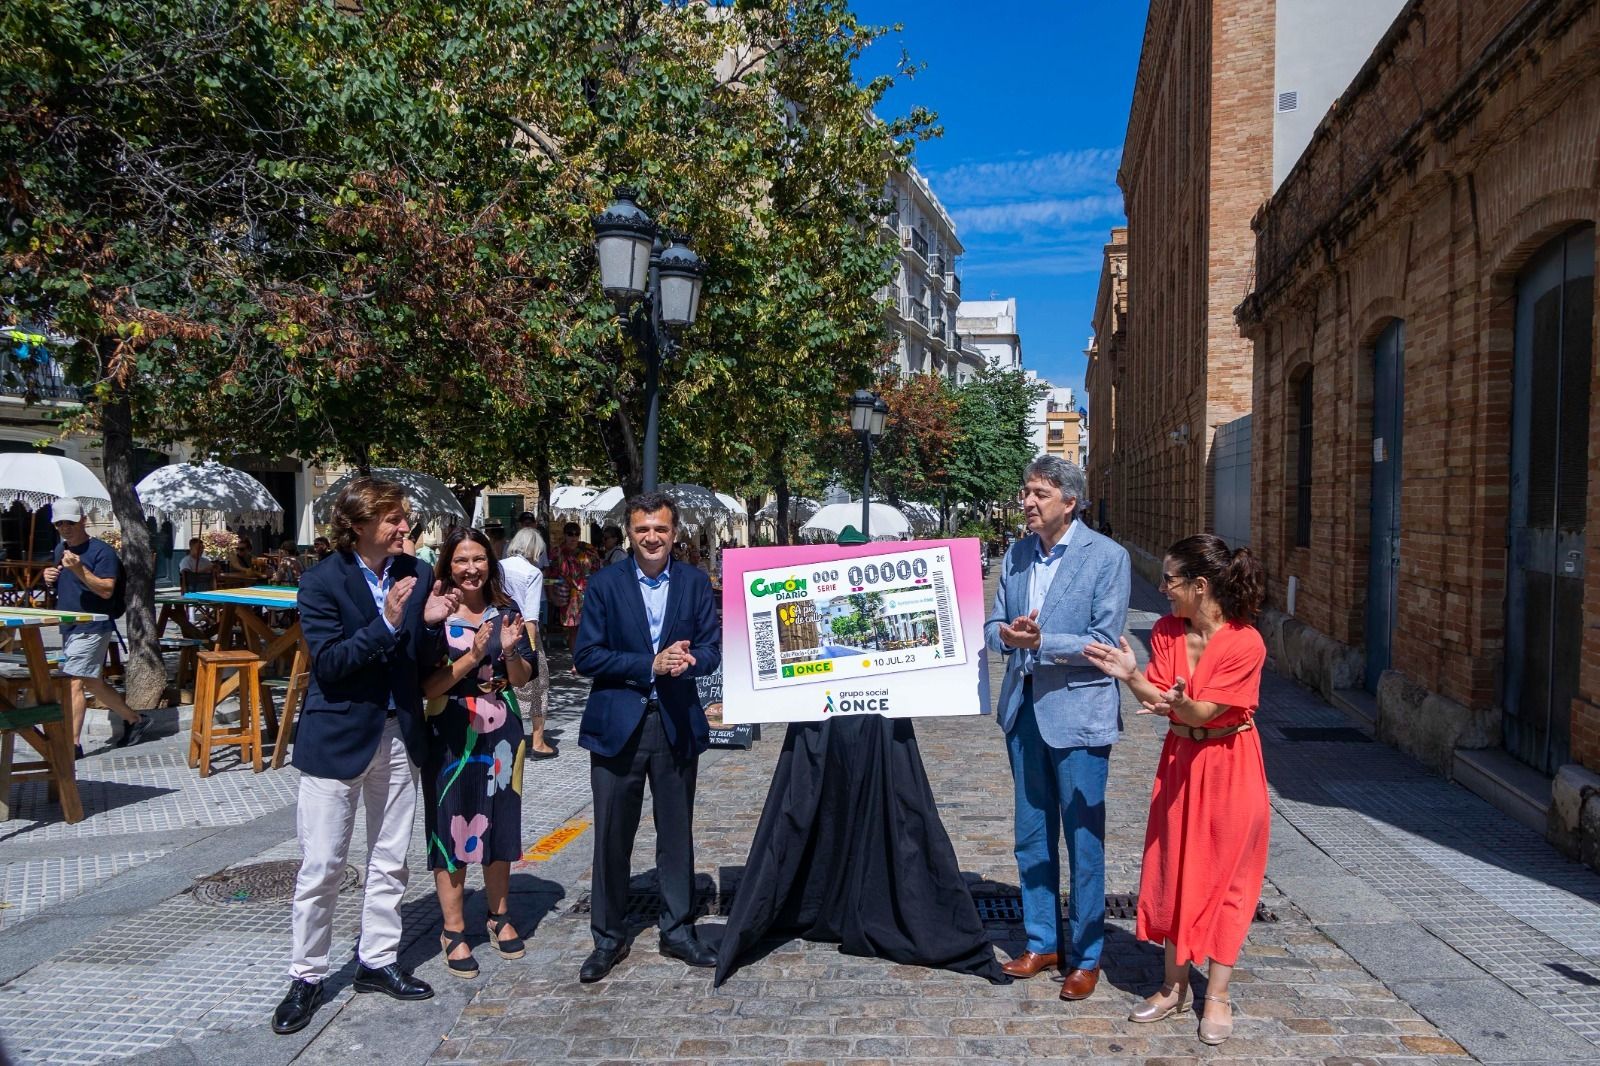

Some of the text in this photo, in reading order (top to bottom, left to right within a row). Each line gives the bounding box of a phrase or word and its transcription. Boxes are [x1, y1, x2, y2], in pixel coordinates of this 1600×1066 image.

[812, 558, 928, 586] 000 00000
[818, 584, 837, 592] SERIE
[874, 658, 884, 667] 10
[904, 654, 916, 664] 23
[796, 662, 830, 674] ONCE
[840, 690, 865, 700] grupo
[840, 699, 890, 712] ONCE
